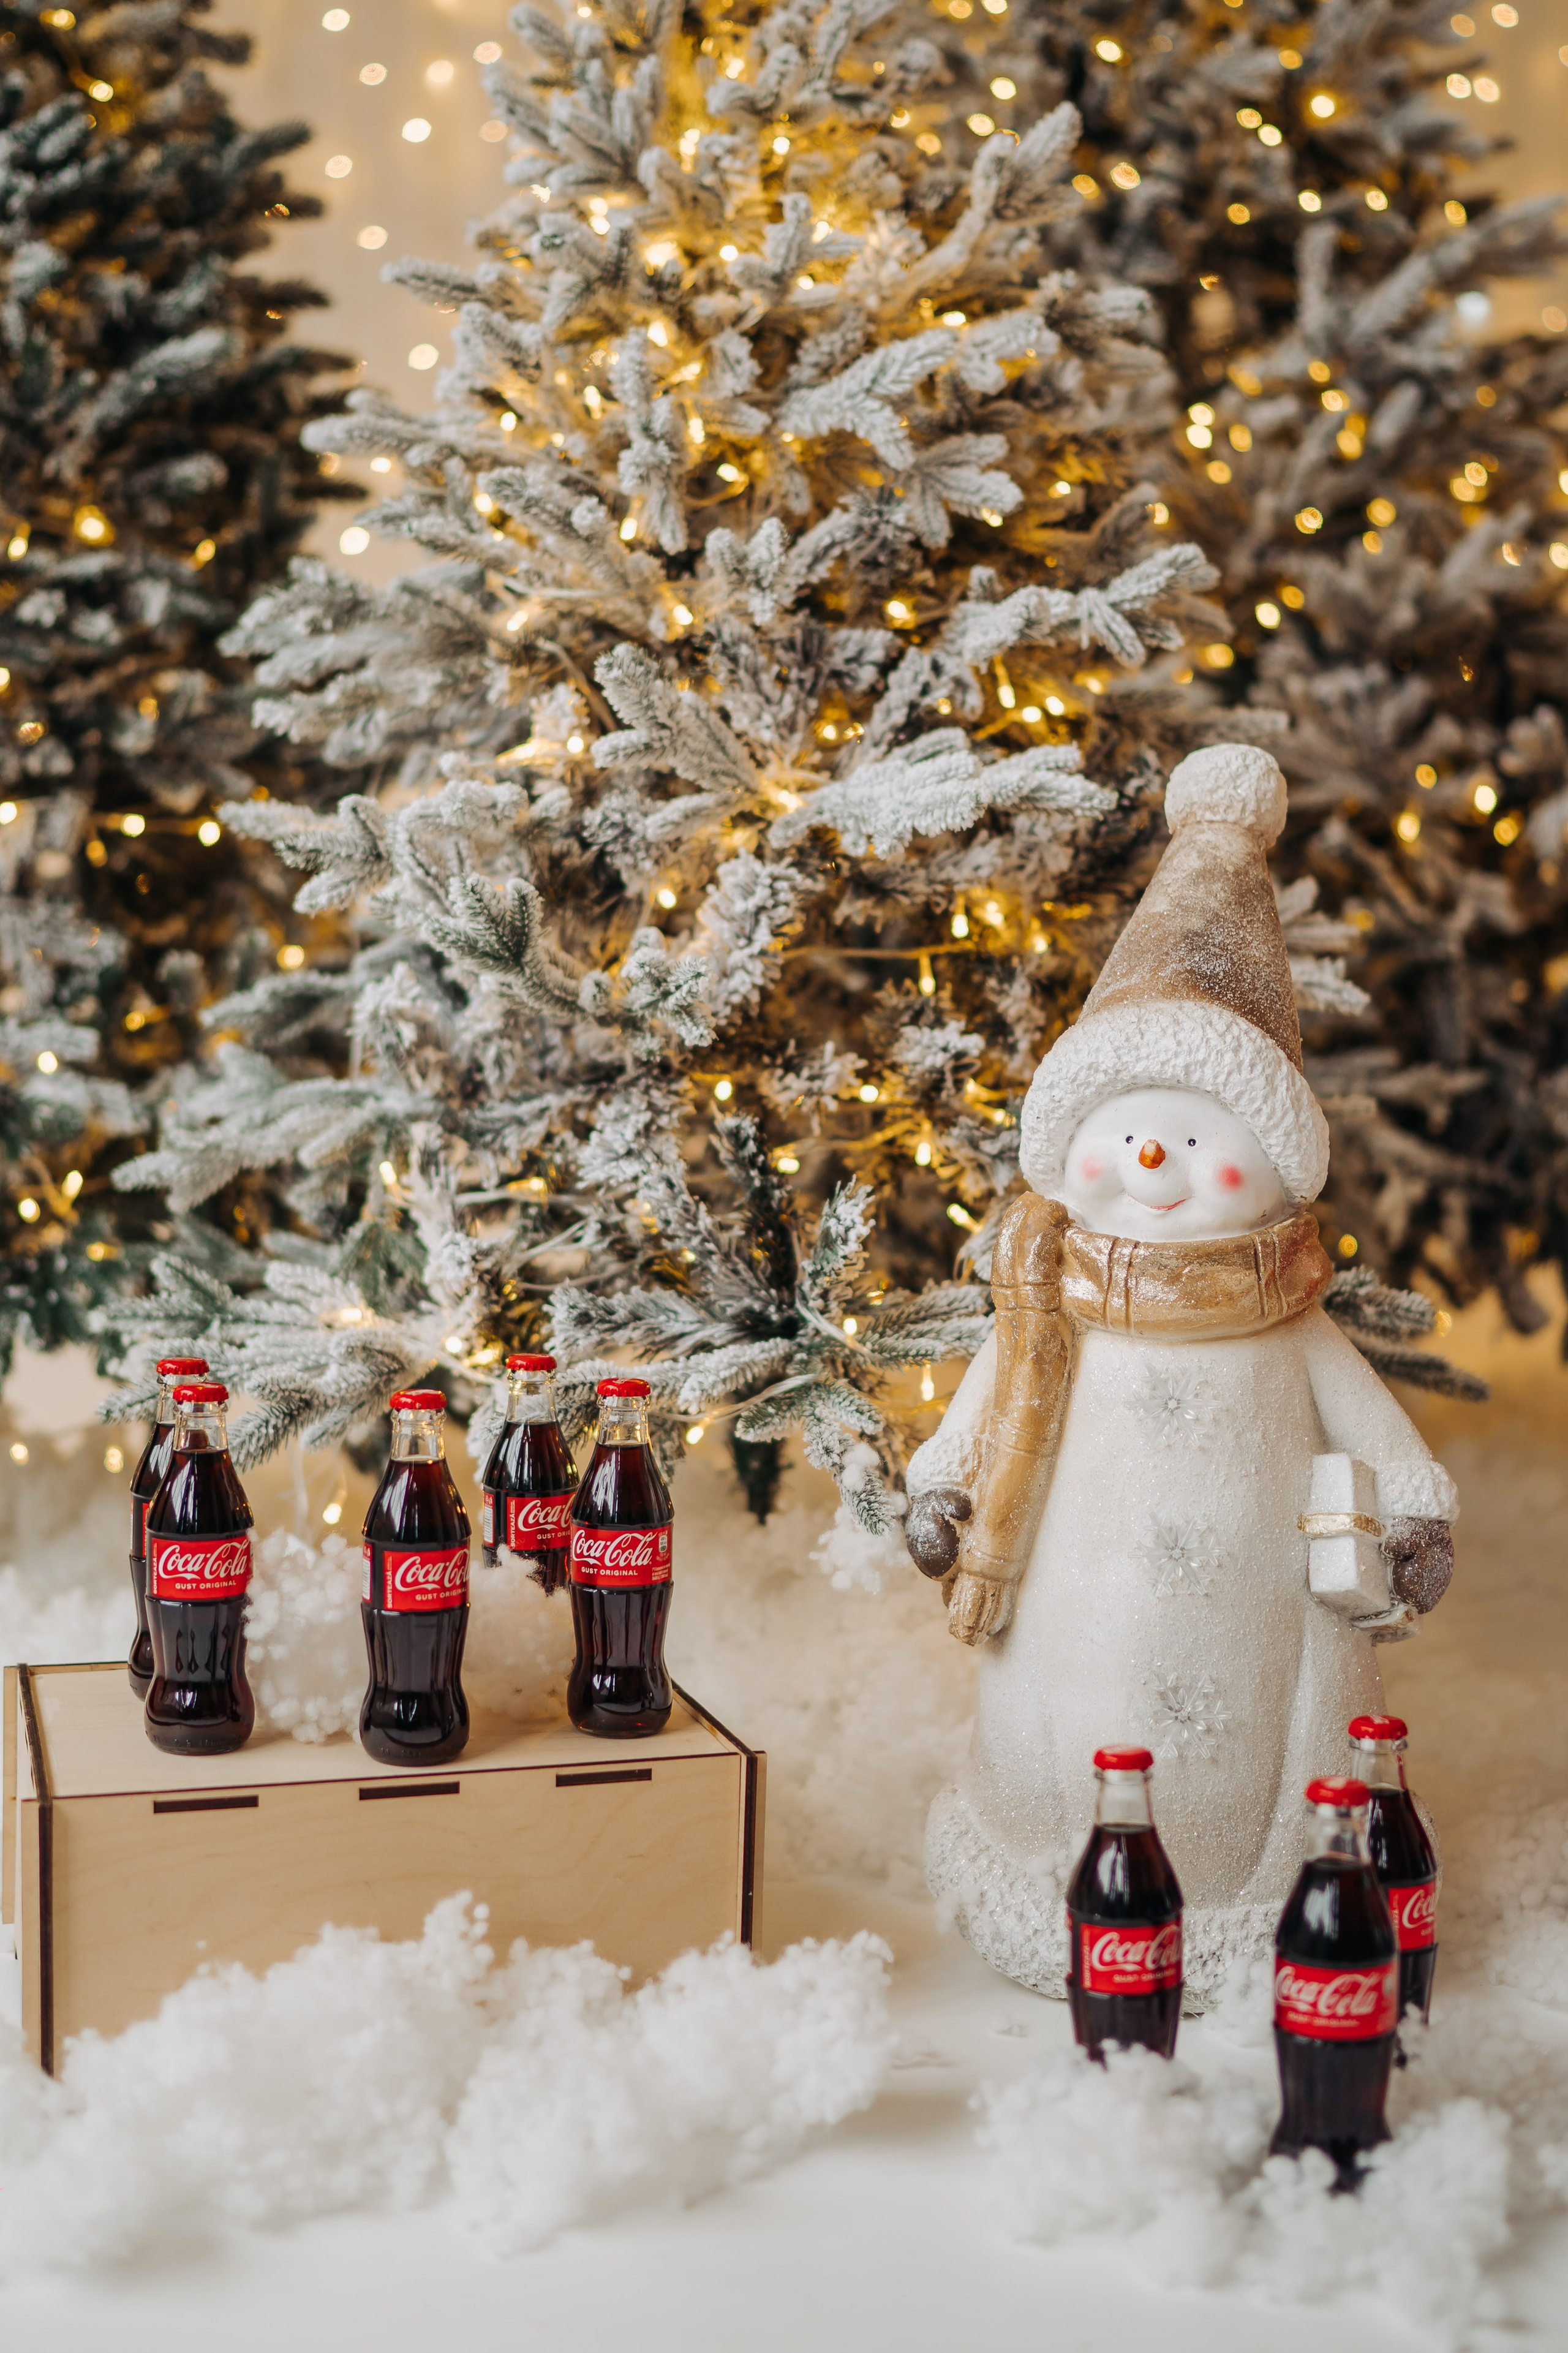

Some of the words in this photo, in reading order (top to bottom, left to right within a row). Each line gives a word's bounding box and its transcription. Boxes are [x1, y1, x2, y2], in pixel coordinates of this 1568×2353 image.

[518, 1494, 575, 1532] Coca-C
[159, 1539, 249, 1580] Coca-Cola
[572, 1529, 658, 1566] Coca-Cola
[200, 1580, 237, 1589] ORIGINAL
[1275, 1965, 1381, 2016] Coca-Cola
